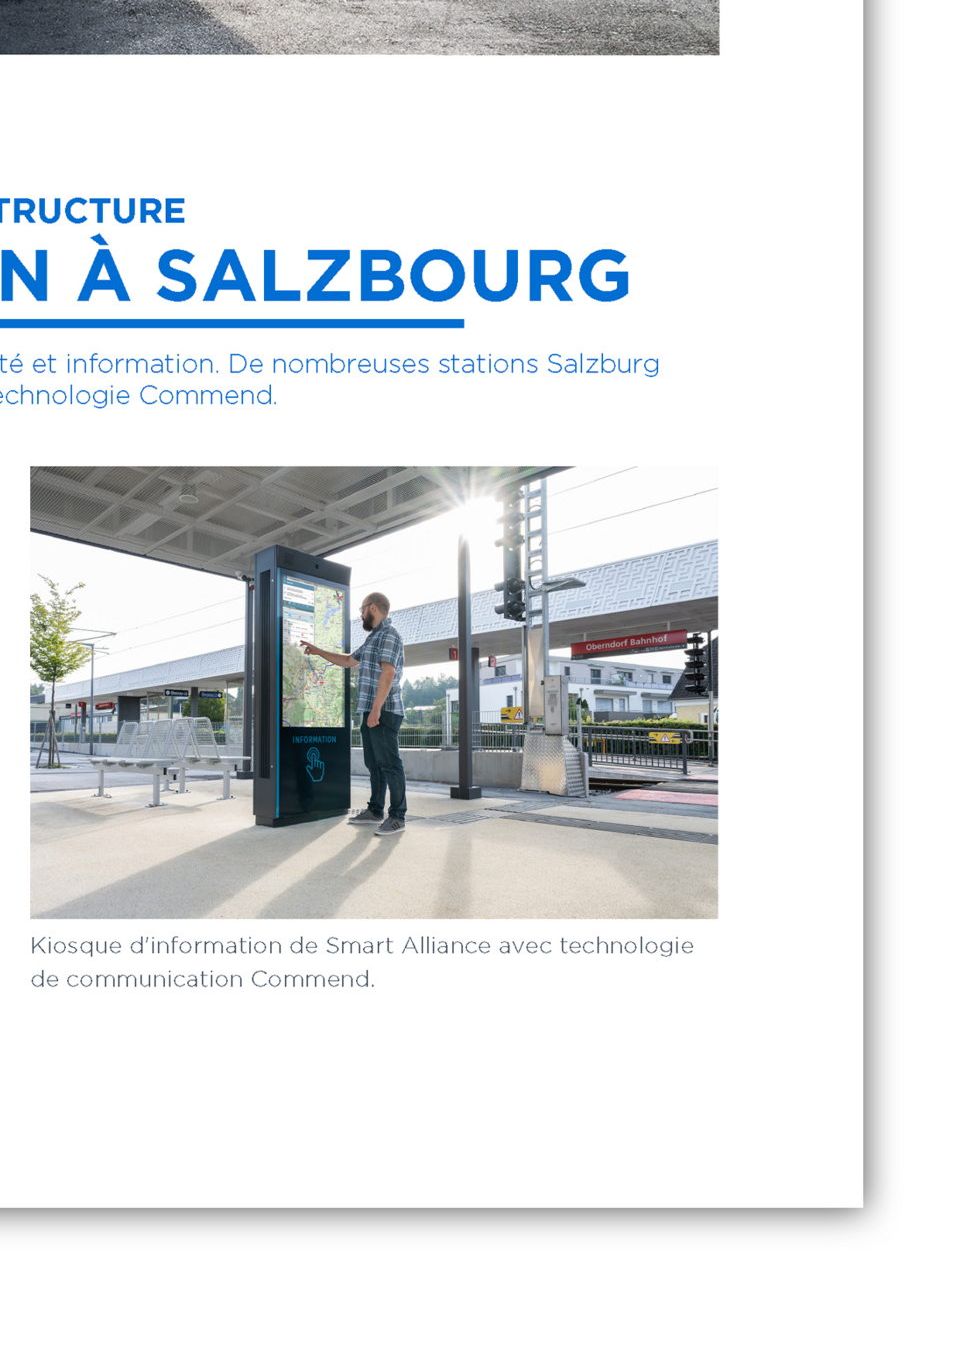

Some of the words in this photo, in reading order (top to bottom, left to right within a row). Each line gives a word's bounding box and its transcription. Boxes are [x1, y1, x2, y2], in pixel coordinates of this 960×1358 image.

[76, 232, 132, 302] À
[155, 248, 630, 303] SALZBOURG
[32, 353, 58, 374] et
[66, 352, 219, 374] information.
[229, 352, 264, 374] De
[272, 352, 430, 374] nombreuses
[438, 353, 539, 374] stations
[547, 352, 660, 378] Salzburg
[139, 383, 277, 406] Commend.
[585, 638, 628, 651] Oberndorf
[630, 634, 668, 646] Bahnhof
[292, 735, 337, 744] INFORMATION
[31, 936, 122, 958] Kiosque
[289, 935, 318, 955] de
[326, 936, 394, 955] Smart
[401, 935, 491, 955] Alliance
[498, 940, 553, 955] avec
[559, 935, 694, 958] technologie
[30, 969, 59, 988] de
[66, 969, 243, 988] communication
[251, 969, 375, 988] Commend.
